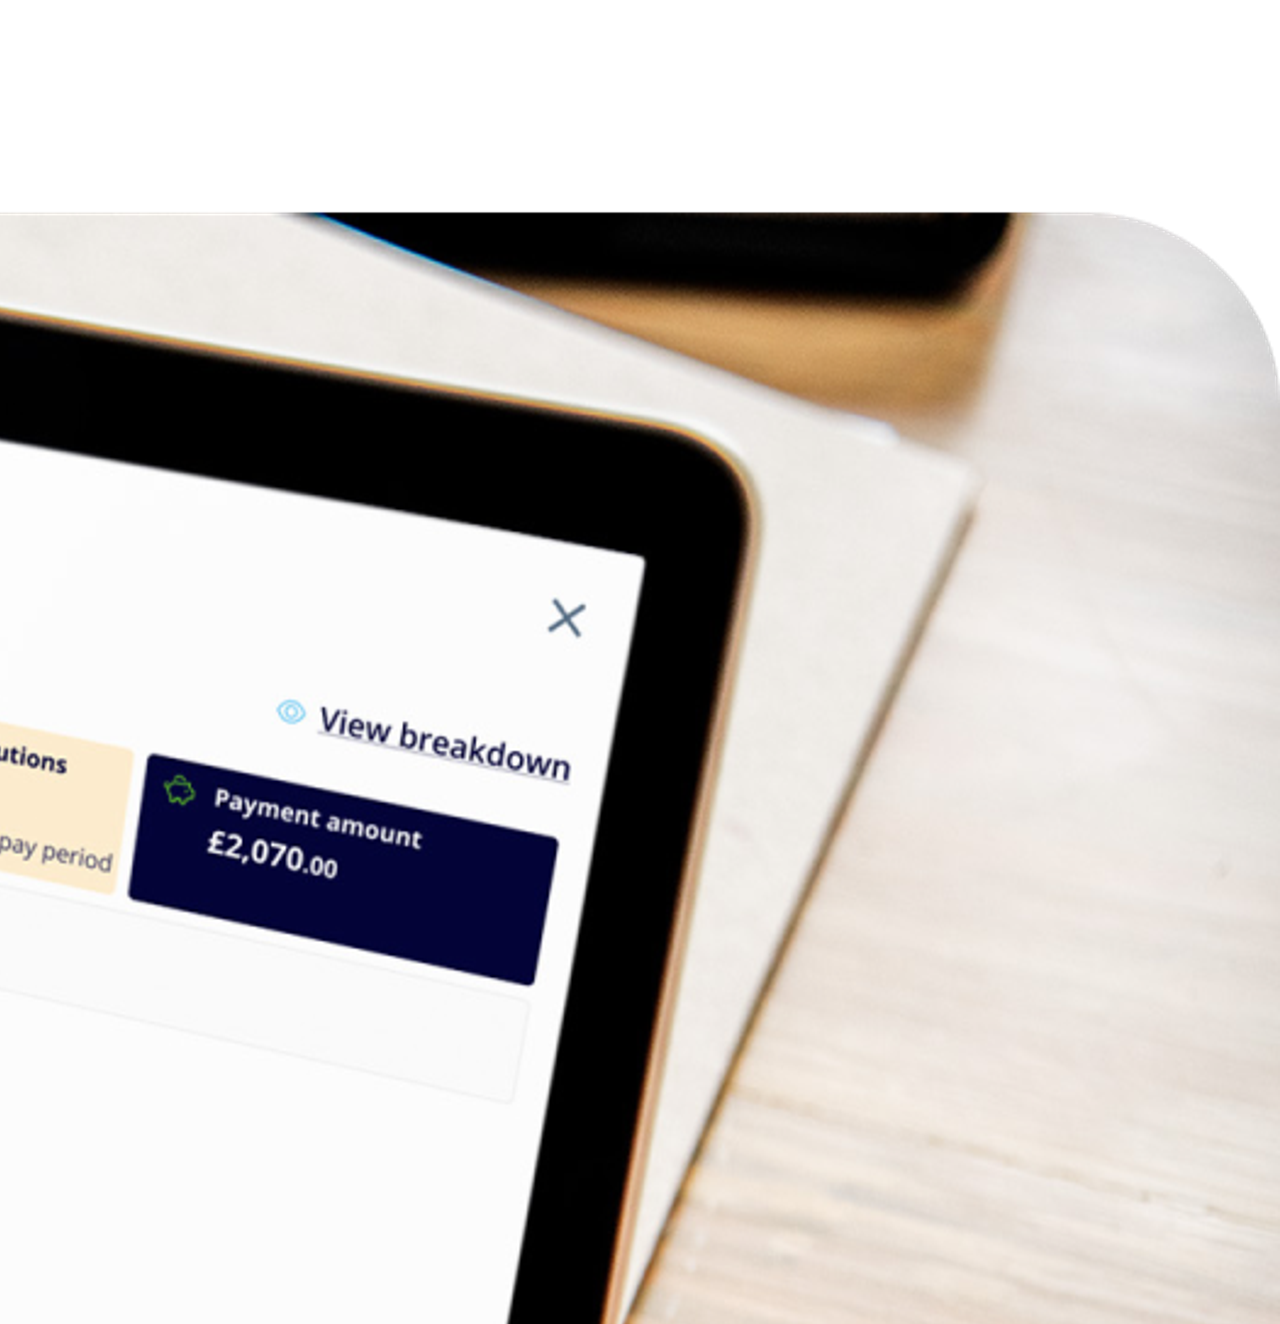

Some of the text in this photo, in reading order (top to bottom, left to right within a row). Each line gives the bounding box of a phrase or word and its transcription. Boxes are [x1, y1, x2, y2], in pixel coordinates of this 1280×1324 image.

[318, 706, 572, 783] View breakdown
[214, 788, 423, 851] Payment amount
[40, 838, 113, 875] period
[207, 829, 338, 880] £2,070.00
